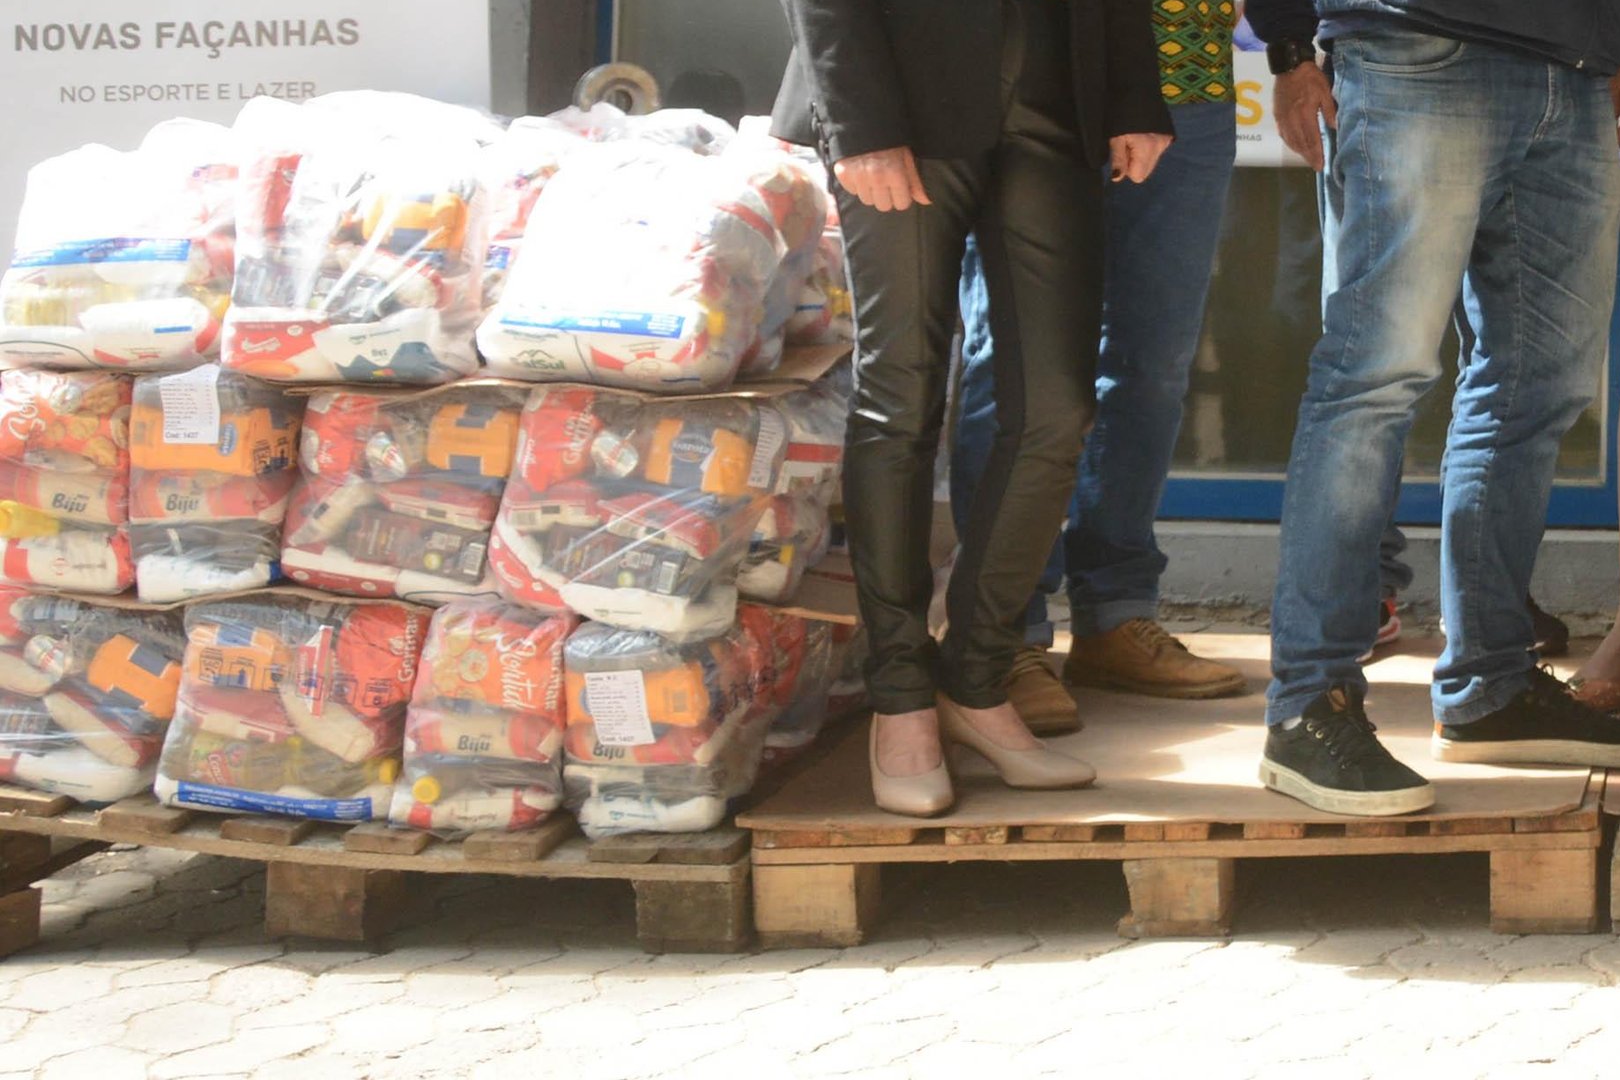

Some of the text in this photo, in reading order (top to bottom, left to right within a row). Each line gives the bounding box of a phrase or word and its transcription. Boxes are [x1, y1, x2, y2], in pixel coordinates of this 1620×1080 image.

[14, 18, 360, 59] NOVAS FAÇANHAS
[60, 81, 316, 103] NO ESPORTE E LAZER
[1235, 80, 1264, 126] S
[52, 493, 90, 513] Biju
[166, 494, 199, 513] Biju
[457, 735, 490, 754] Biju
